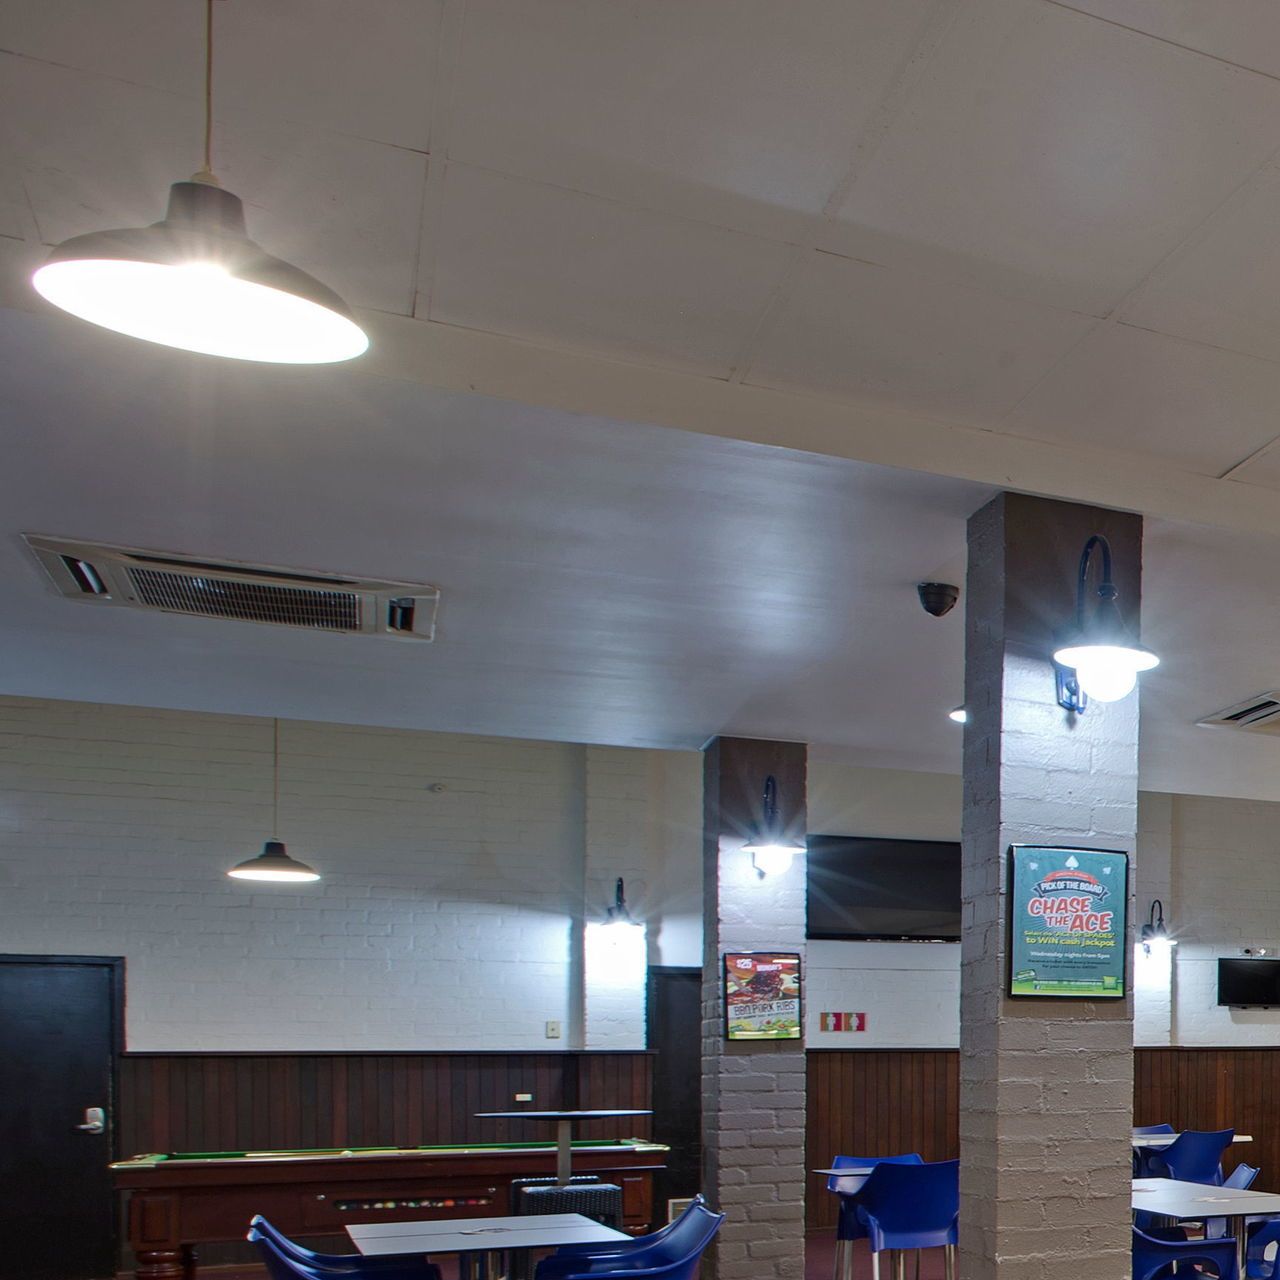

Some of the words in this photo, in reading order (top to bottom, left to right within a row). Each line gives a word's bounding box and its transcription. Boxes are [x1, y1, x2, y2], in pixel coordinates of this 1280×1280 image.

[1041, 881, 1057, 891] PICK
[1057, 880, 1066, 889] OF
[1066, 881, 1079, 889] THE
[1079, 882, 1103, 893] BOARD
[1029, 897, 1092, 916] CHASE
[1046, 915, 1071, 926] THE
[1069, 913, 1113, 932] ACE
[1038, 937, 1058, 945] WIN
[752, 1003, 774, 1015] PORK
[776, 1000, 795, 1012] RIBS
